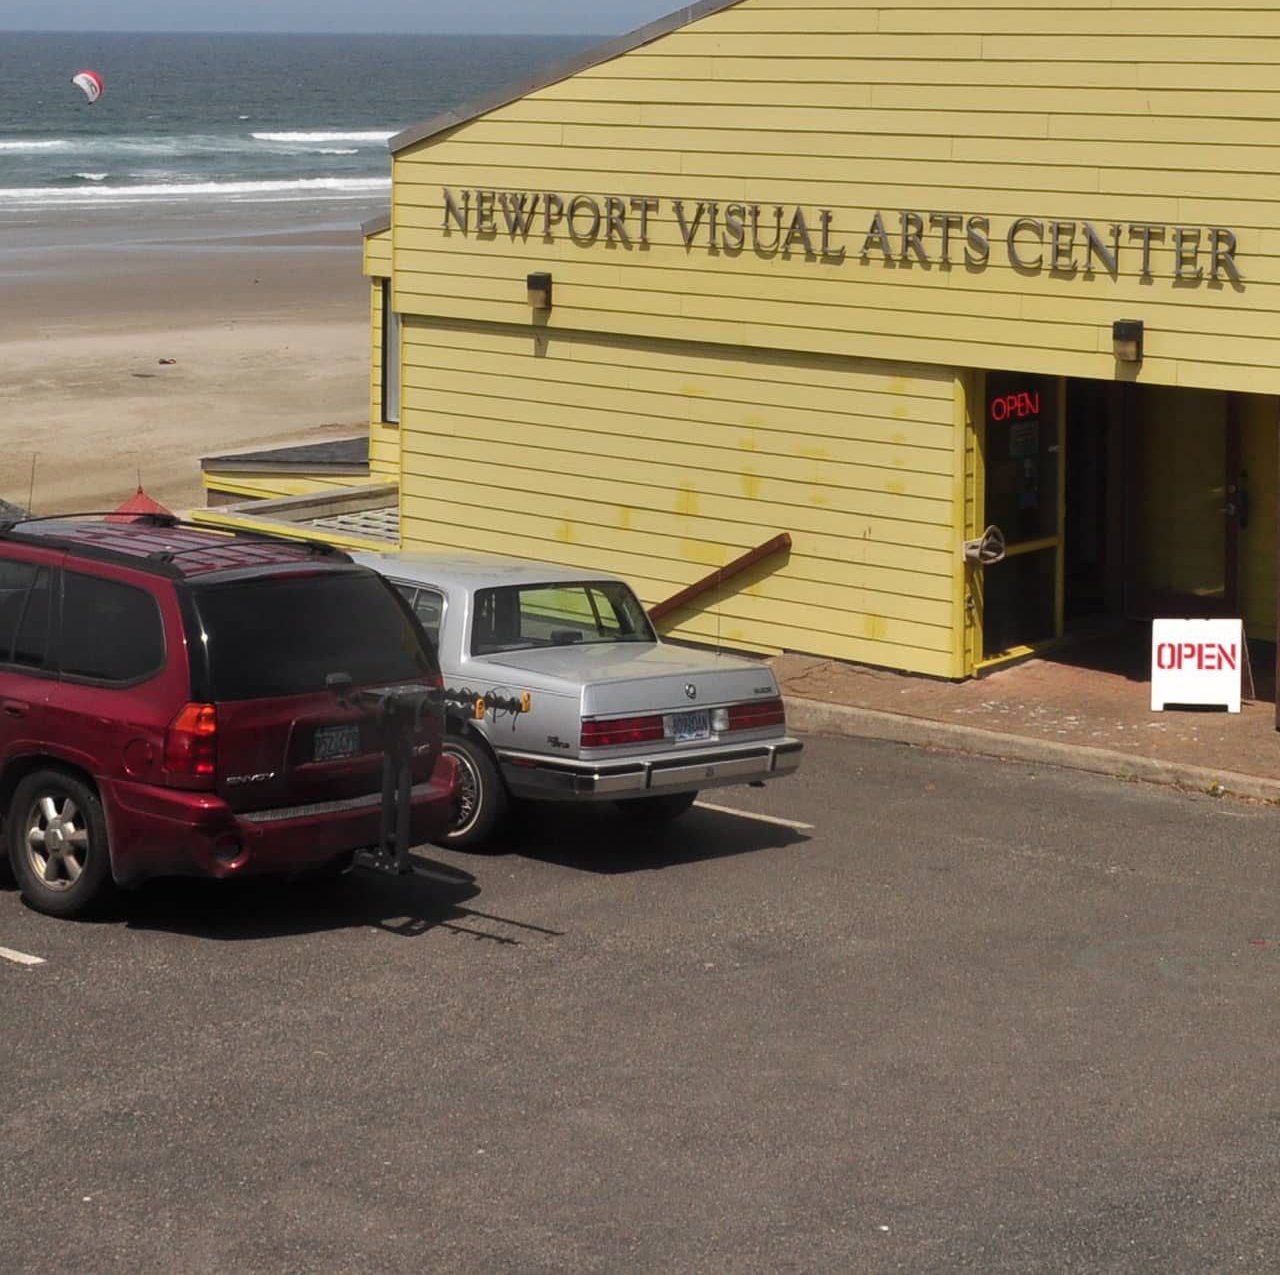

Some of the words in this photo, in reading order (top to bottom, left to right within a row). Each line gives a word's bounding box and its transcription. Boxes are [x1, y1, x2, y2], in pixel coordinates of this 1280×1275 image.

[442, 187, 659, 249] NEWPORT
[672, 196, 846, 262] VISUAL
[860, 209, 990, 271] ARTS
[1007, 217, 1245, 291] CENTER
[991, 392, 1040, 421] OPEN
[1156, 642, 1237, 671] OPEN
